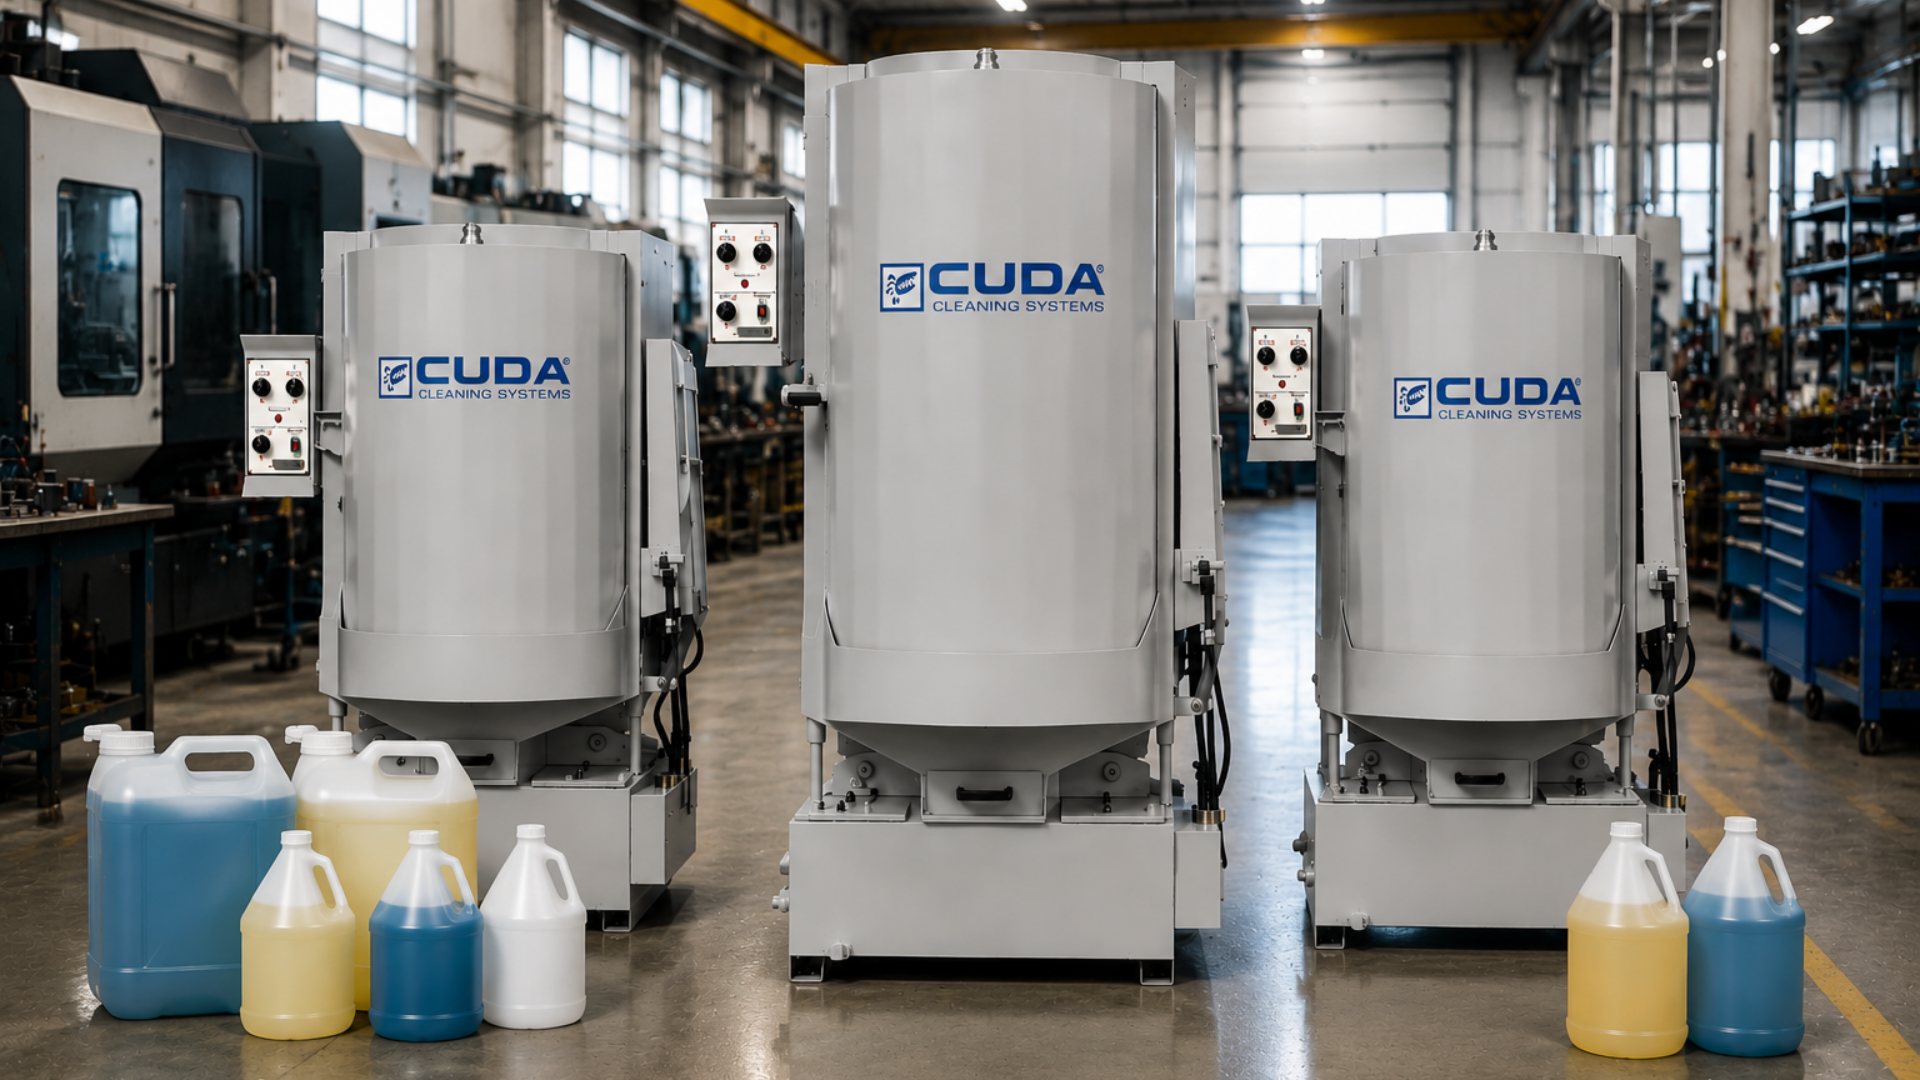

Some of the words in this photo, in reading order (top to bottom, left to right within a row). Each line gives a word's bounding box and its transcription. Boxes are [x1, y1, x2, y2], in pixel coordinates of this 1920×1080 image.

[932, 300, 1020, 312] CLEANING
[1025, 300, 1105, 312] SYSTEMS
[418, 389, 492, 400] CLEANING
[498, 389, 571, 400] SYSTEMS
[1438, 409, 1513, 420] CLEANING
[1518, 409, 1582, 420] SYSTEMS
